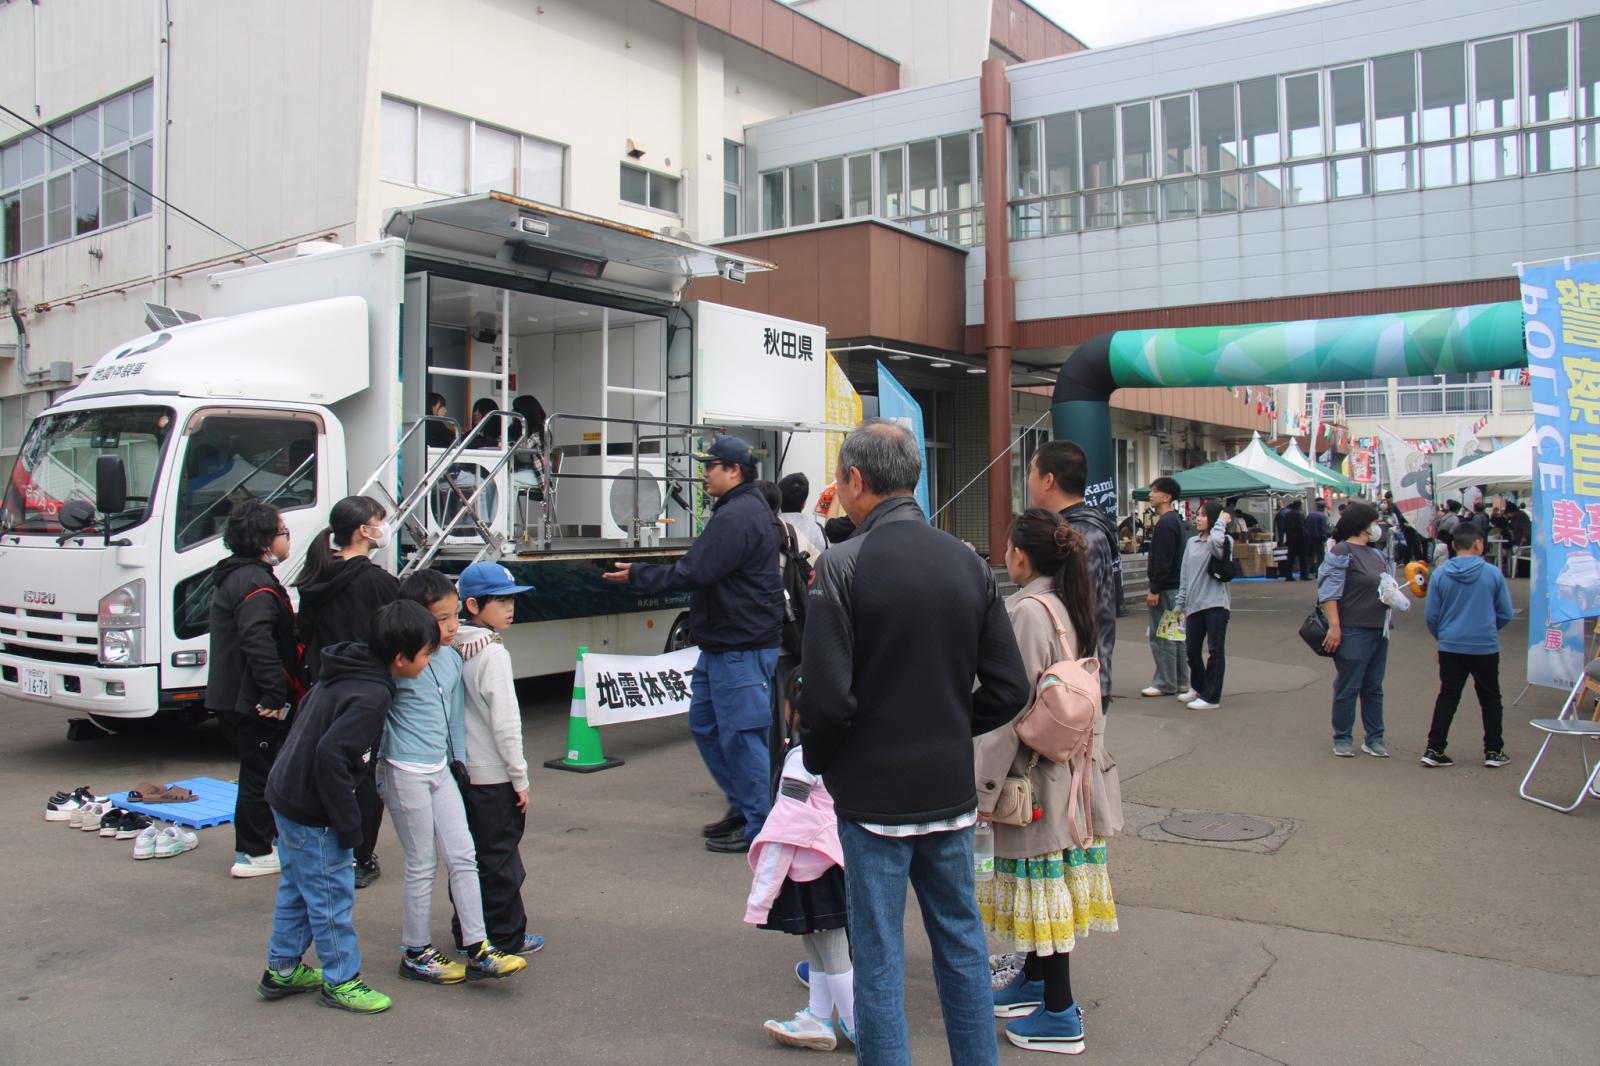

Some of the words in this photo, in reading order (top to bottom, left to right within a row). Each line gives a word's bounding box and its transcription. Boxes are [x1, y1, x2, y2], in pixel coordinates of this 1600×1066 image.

[763, 327, 813, 361] 秋田県
[24, 590, 56, 604] ISUZU
[596, 668, 694, 709] 地震体験
